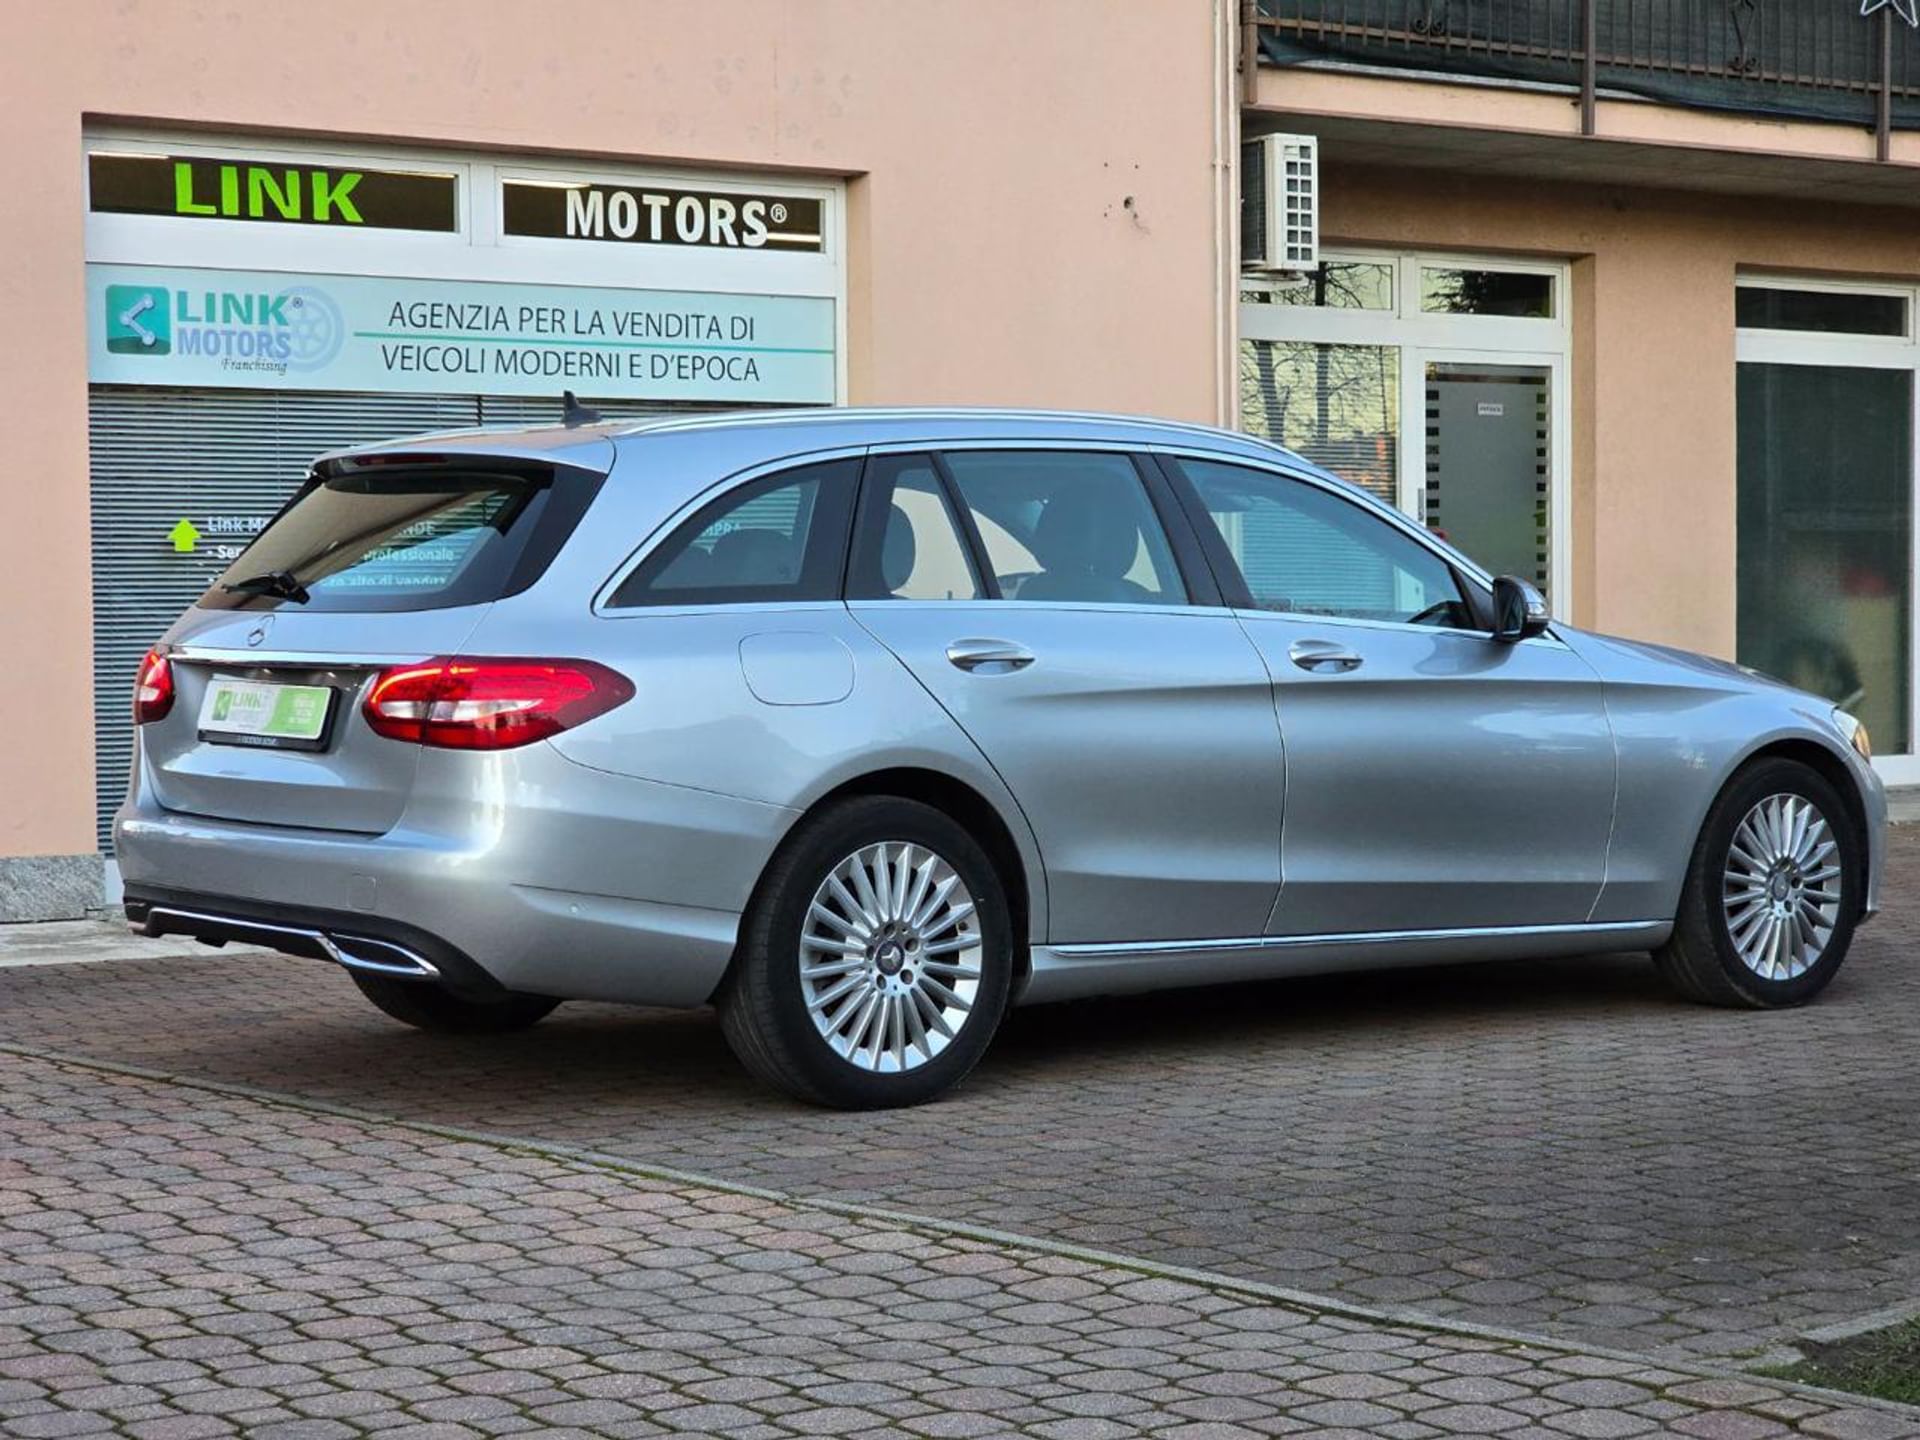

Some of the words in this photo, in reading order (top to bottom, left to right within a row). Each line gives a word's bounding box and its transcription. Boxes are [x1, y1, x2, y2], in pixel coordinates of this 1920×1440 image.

[174, 162, 364, 223] LINK
[388, 301, 510, 332] AGENZIA
[519, 307, 566, 334] PER
[574, 309, 606, 336] LA
[612, 311, 723, 340] VENDITA
[731, 315, 754, 341] DI
[176, 328, 291, 360] MOTORS
[222, 358, 288, 376] Franchising
[382, 344, 485, 374] VEICOLI
[494, 349, 620, 378] MODERNI
[629, 353, 643, 378] E
[651, 354, 760, 381] D'EPOCA
[208, 516, 242, 532] Link
